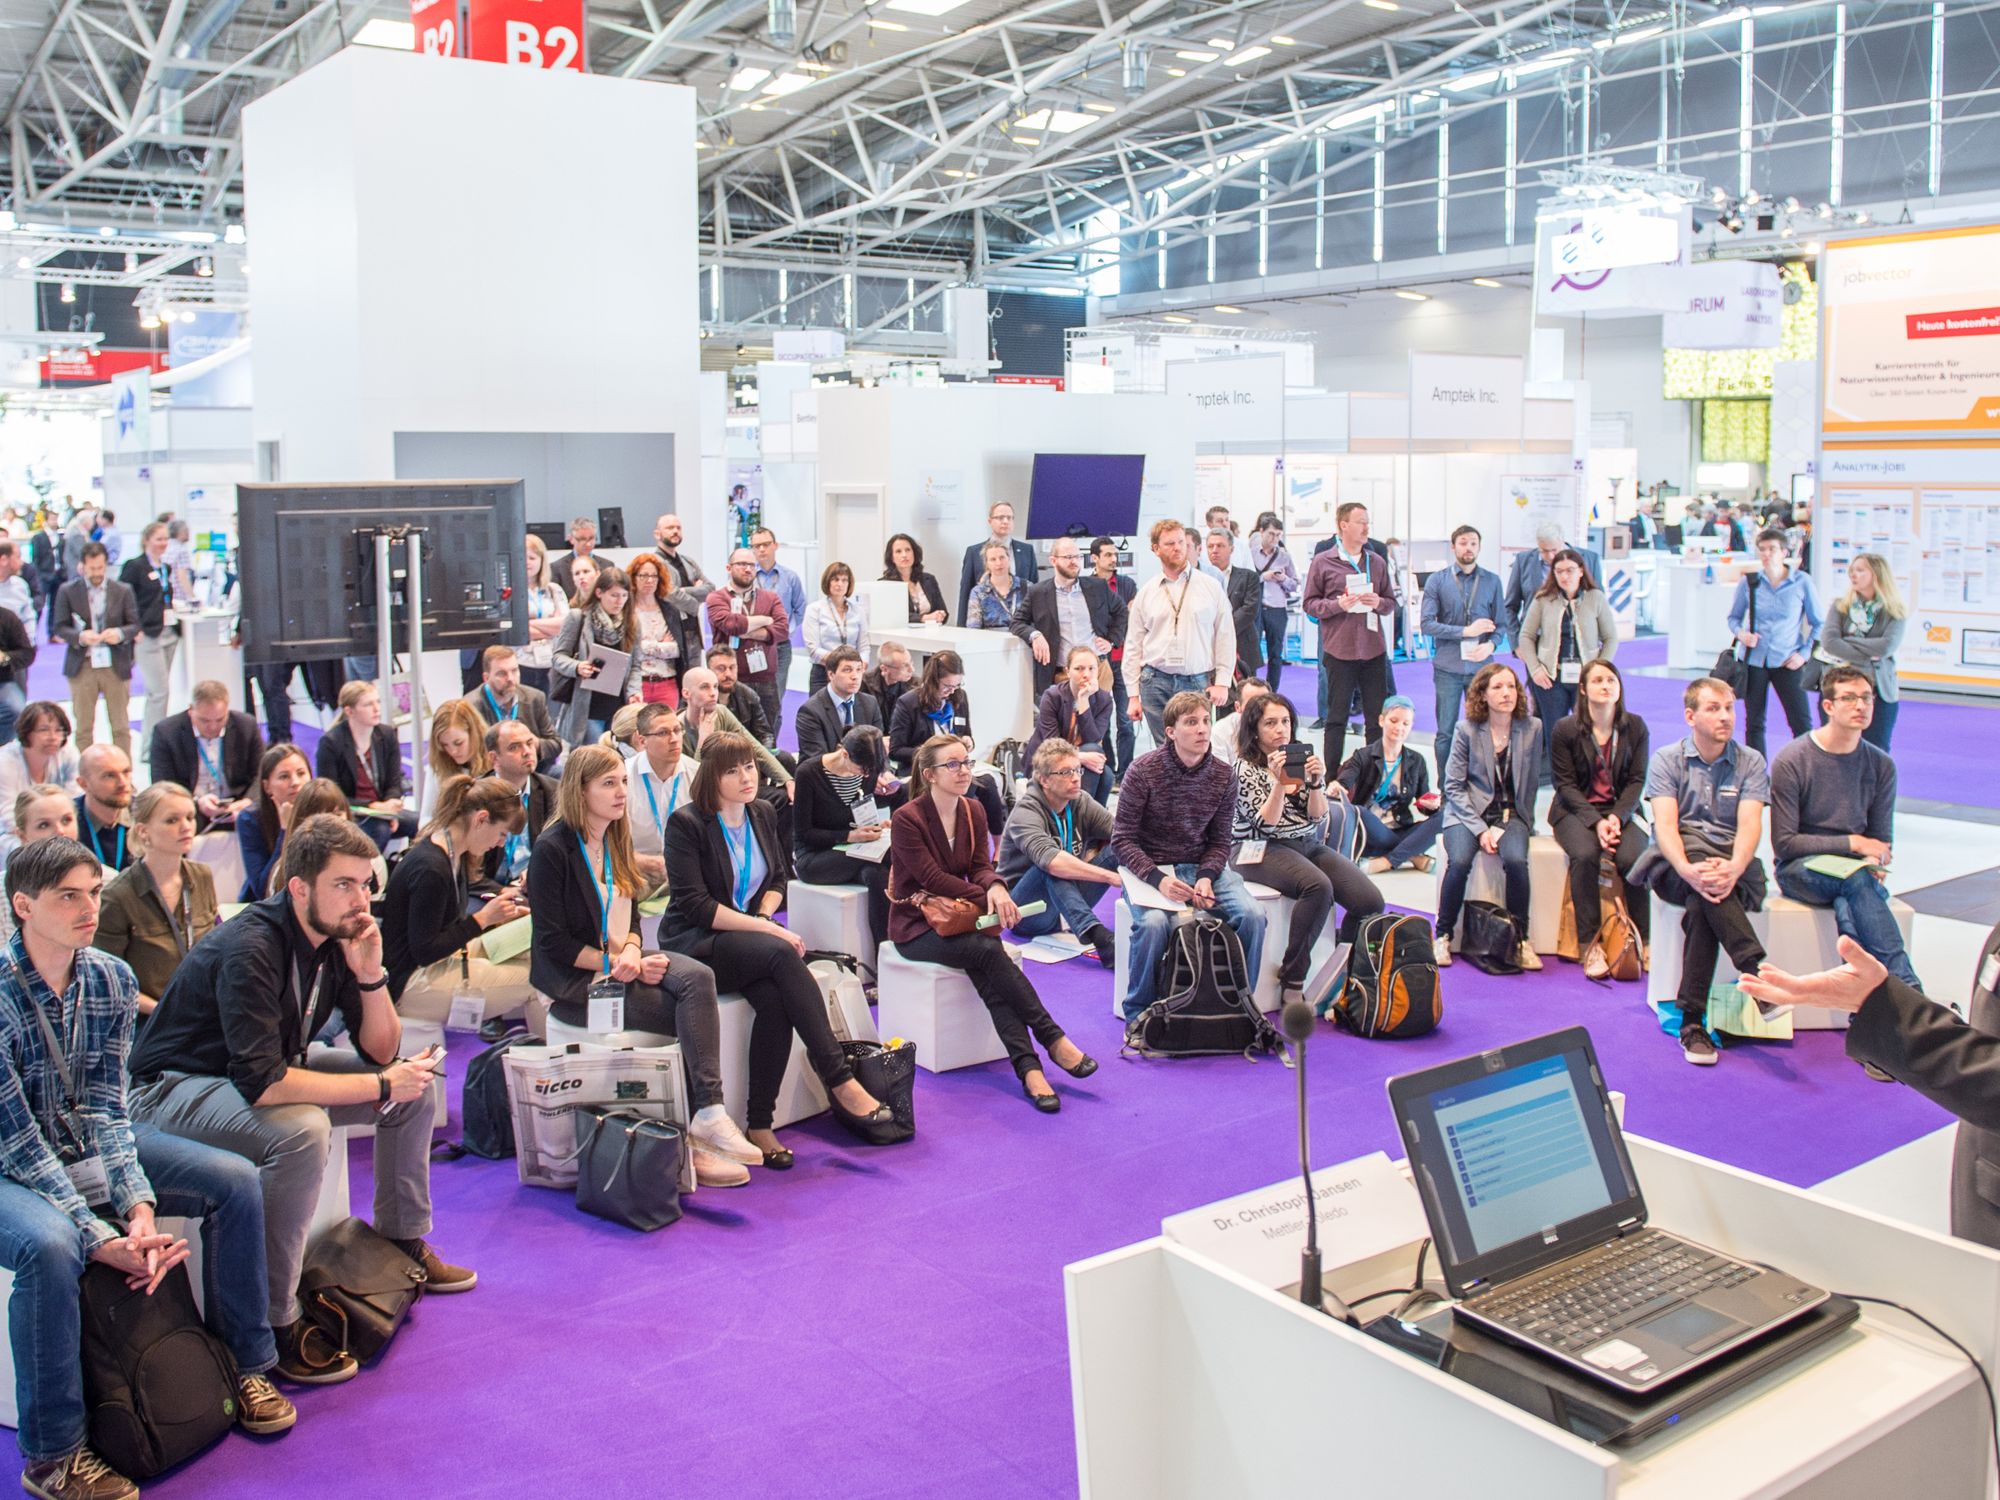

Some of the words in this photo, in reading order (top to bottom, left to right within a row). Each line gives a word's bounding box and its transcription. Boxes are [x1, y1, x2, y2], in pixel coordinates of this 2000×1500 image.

[505, 19, 579, 72] B2
[1843, 267, 1914, 288] jobvector
[1690, 296, 1725, 312] RUM
[1875, 360, 1944, 371] Karrieretrends
[1946, 359, 1960, 369] für
[1839, 372, 1936, 385] Naturwissenschaftler
[1188, 390, 1230, 409] mptek
[1233, 389, 1255, 404] Inc.
[1432, 386, 1476, 405] Amptek
[1479, 387, 1500, 404] Inc.
[1213, 1217, 1239, 1231] Dr.
[1238, 1193, 1307, 1223] Christoph
[1311, 1177, 1362, 1201] Jansen
[1262, 1219, 1306, 1240] Mettler
